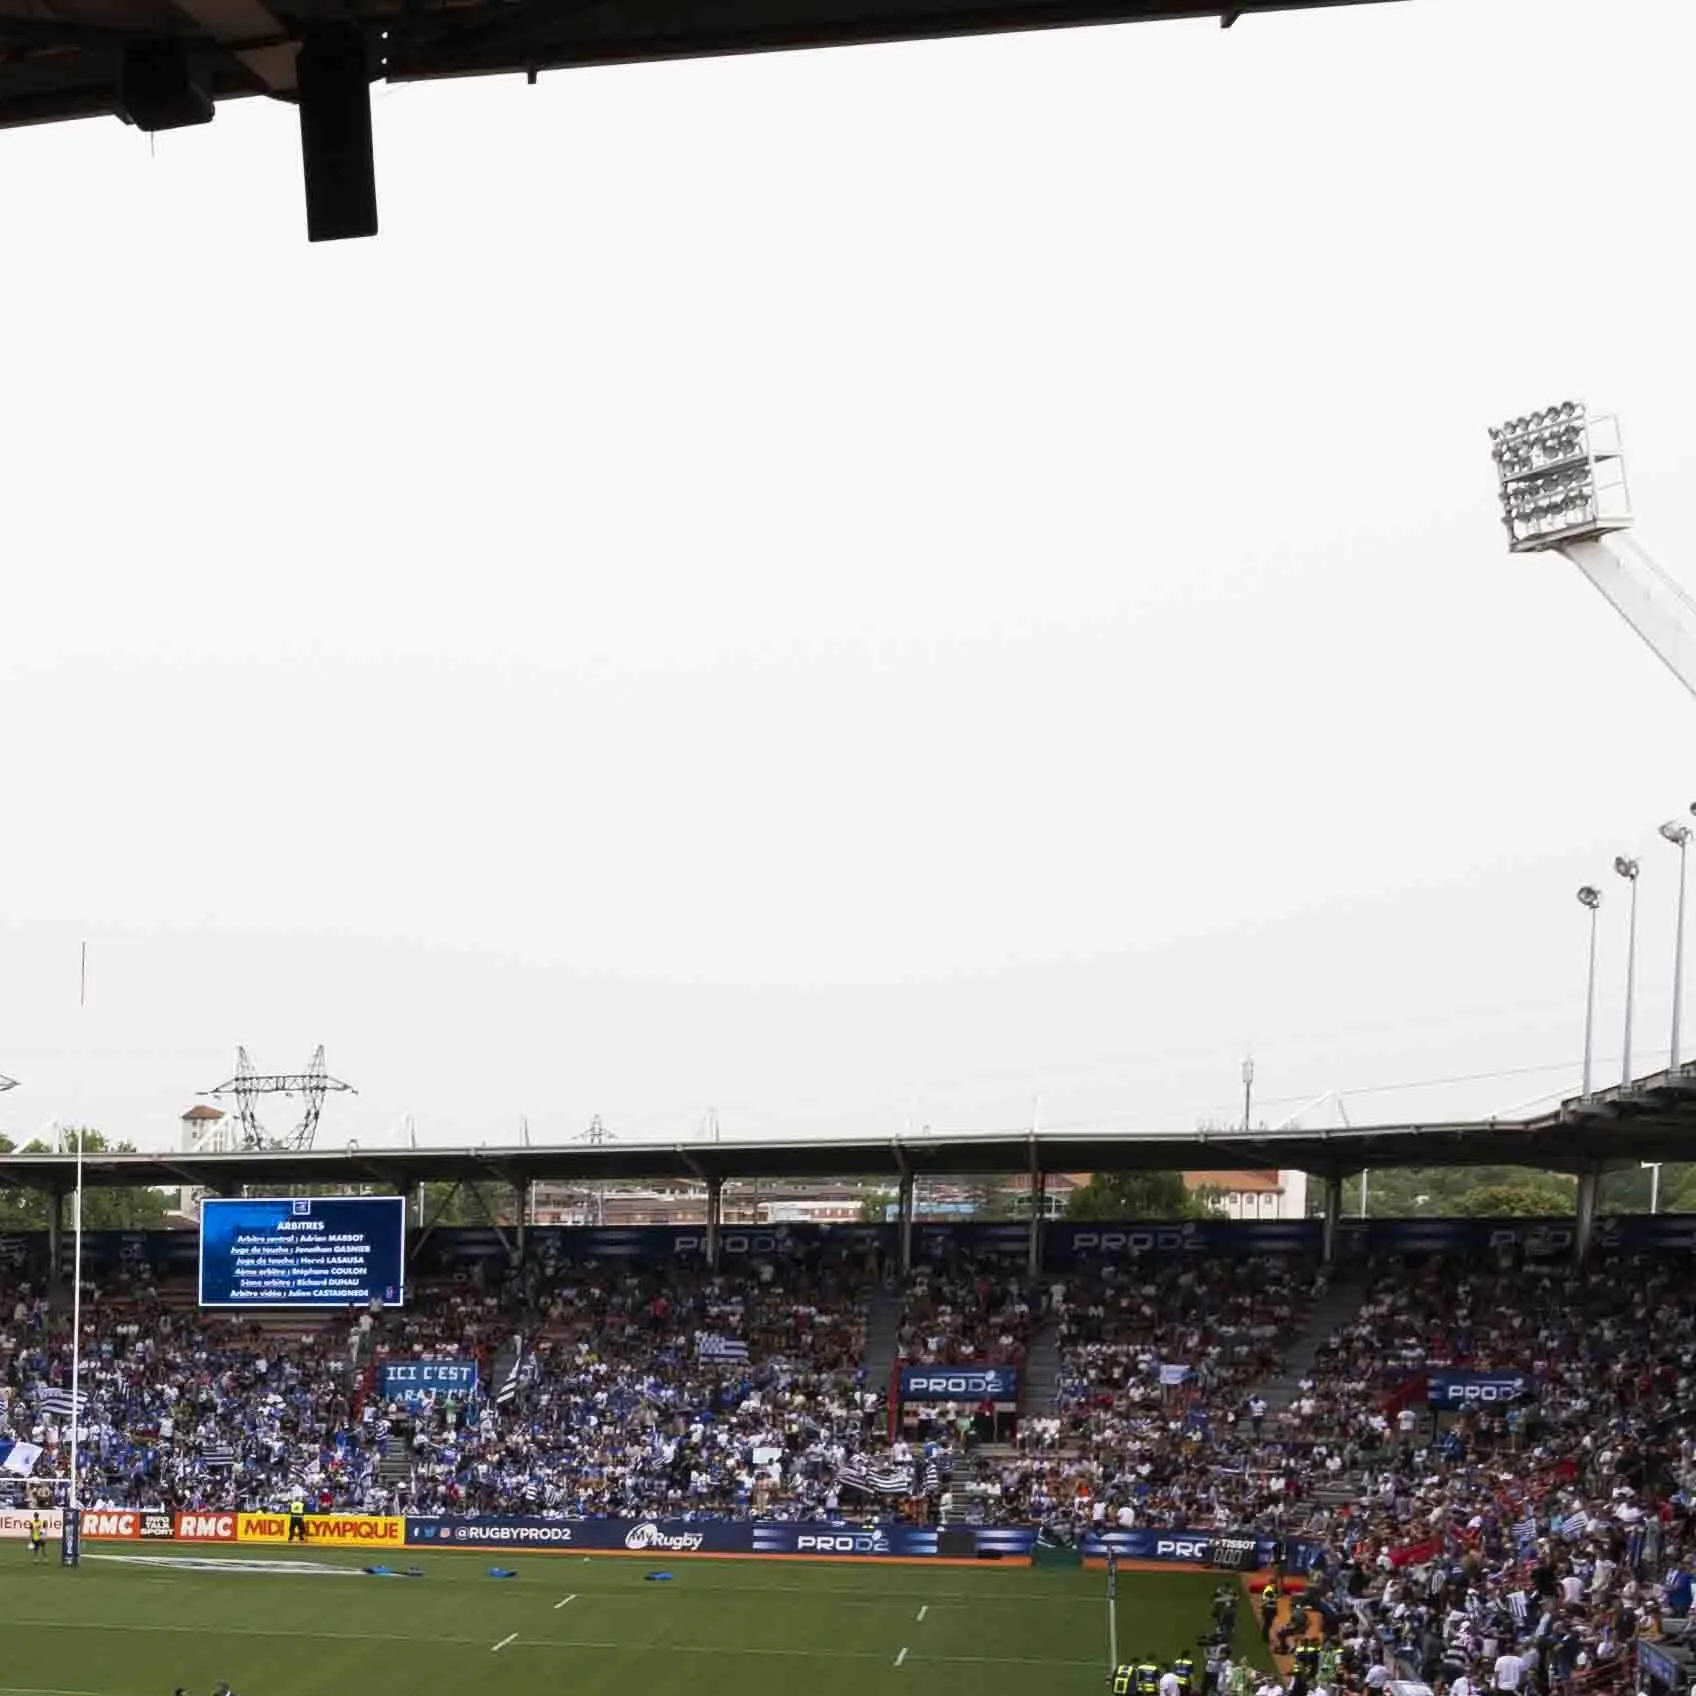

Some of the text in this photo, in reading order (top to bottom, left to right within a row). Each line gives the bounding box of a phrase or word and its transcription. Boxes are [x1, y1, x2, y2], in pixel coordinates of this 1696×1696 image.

[277, 1221, 325, 1231] ARBITRES
[386, 1366, 471, 1381] ICI C'EST
[909, 1378, 1004, 1392] PROD2
[82, 1514, 135, 1536] RMC
[180, 1516, 233, 1537] RMC
[244, 1518, 399, 1540] MIDI LYMPIQUE
[455, 1526, 571, 1541] @RUGBYPROD2
[797, 1536, 890, 1552] PROD2
[1157, 1541, 1208, 1557] PRO
